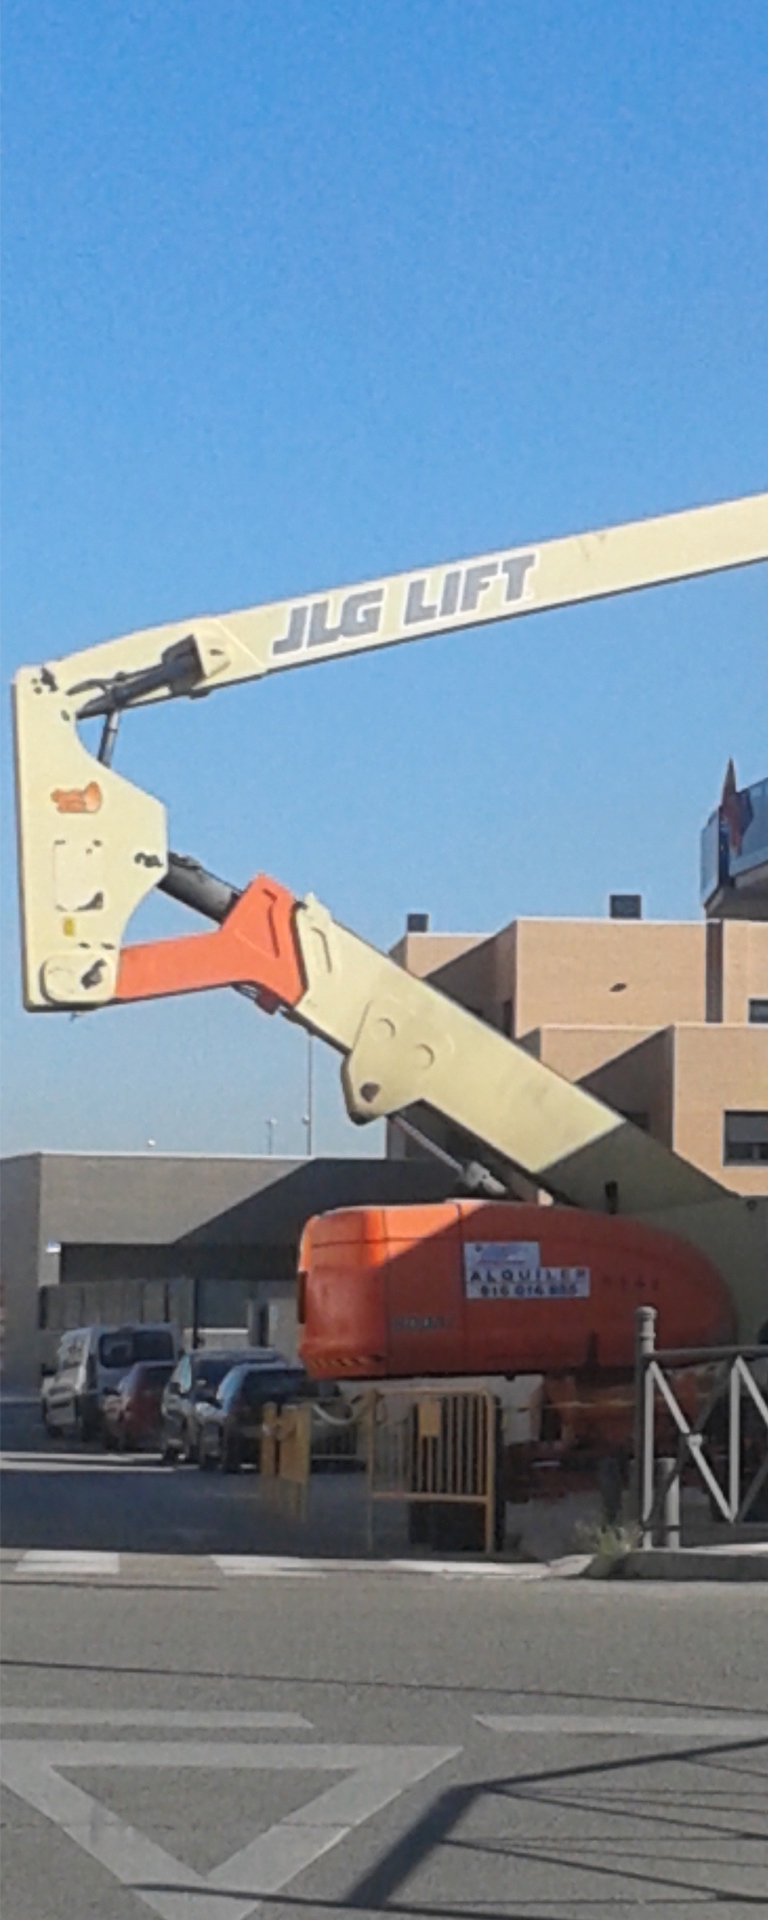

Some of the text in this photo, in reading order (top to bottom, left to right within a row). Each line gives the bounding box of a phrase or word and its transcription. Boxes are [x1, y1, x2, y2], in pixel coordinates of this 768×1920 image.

[272, 553, 536, 655] JLG LIFT
[470, 1268, 586, 1283] ALQUILER
